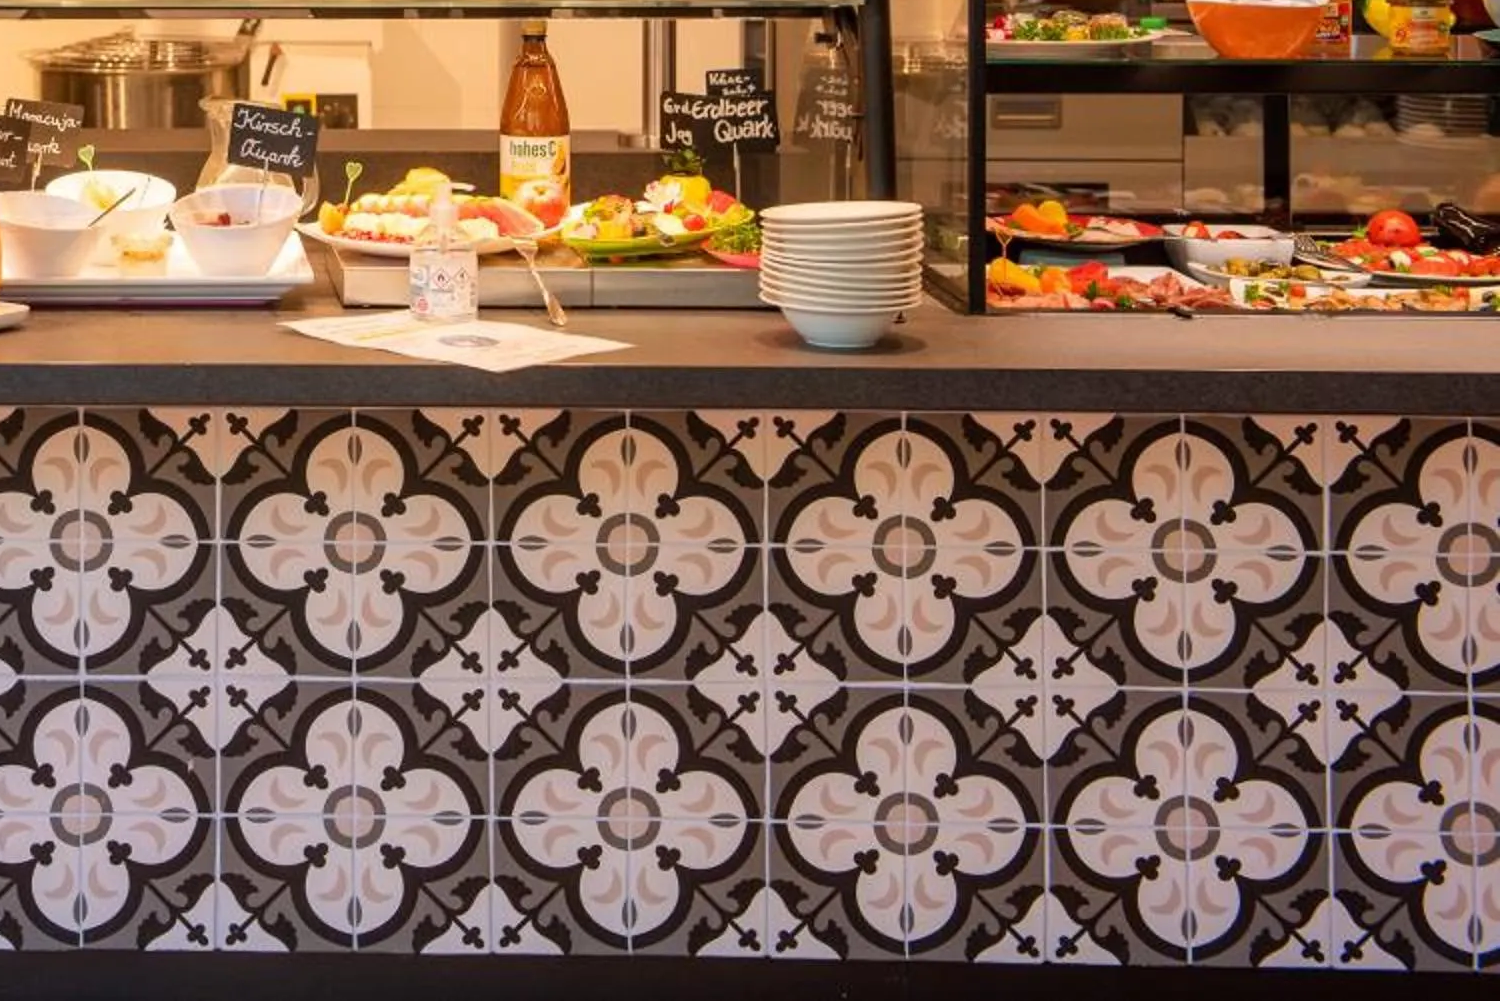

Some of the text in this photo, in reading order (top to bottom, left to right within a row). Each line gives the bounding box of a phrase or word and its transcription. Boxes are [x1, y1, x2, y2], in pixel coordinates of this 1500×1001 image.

[233, 108, 314, 138] Kirsch-
[691, 98, 769, 119] Erdbeer
[714, 113, 775, 143] Quark
